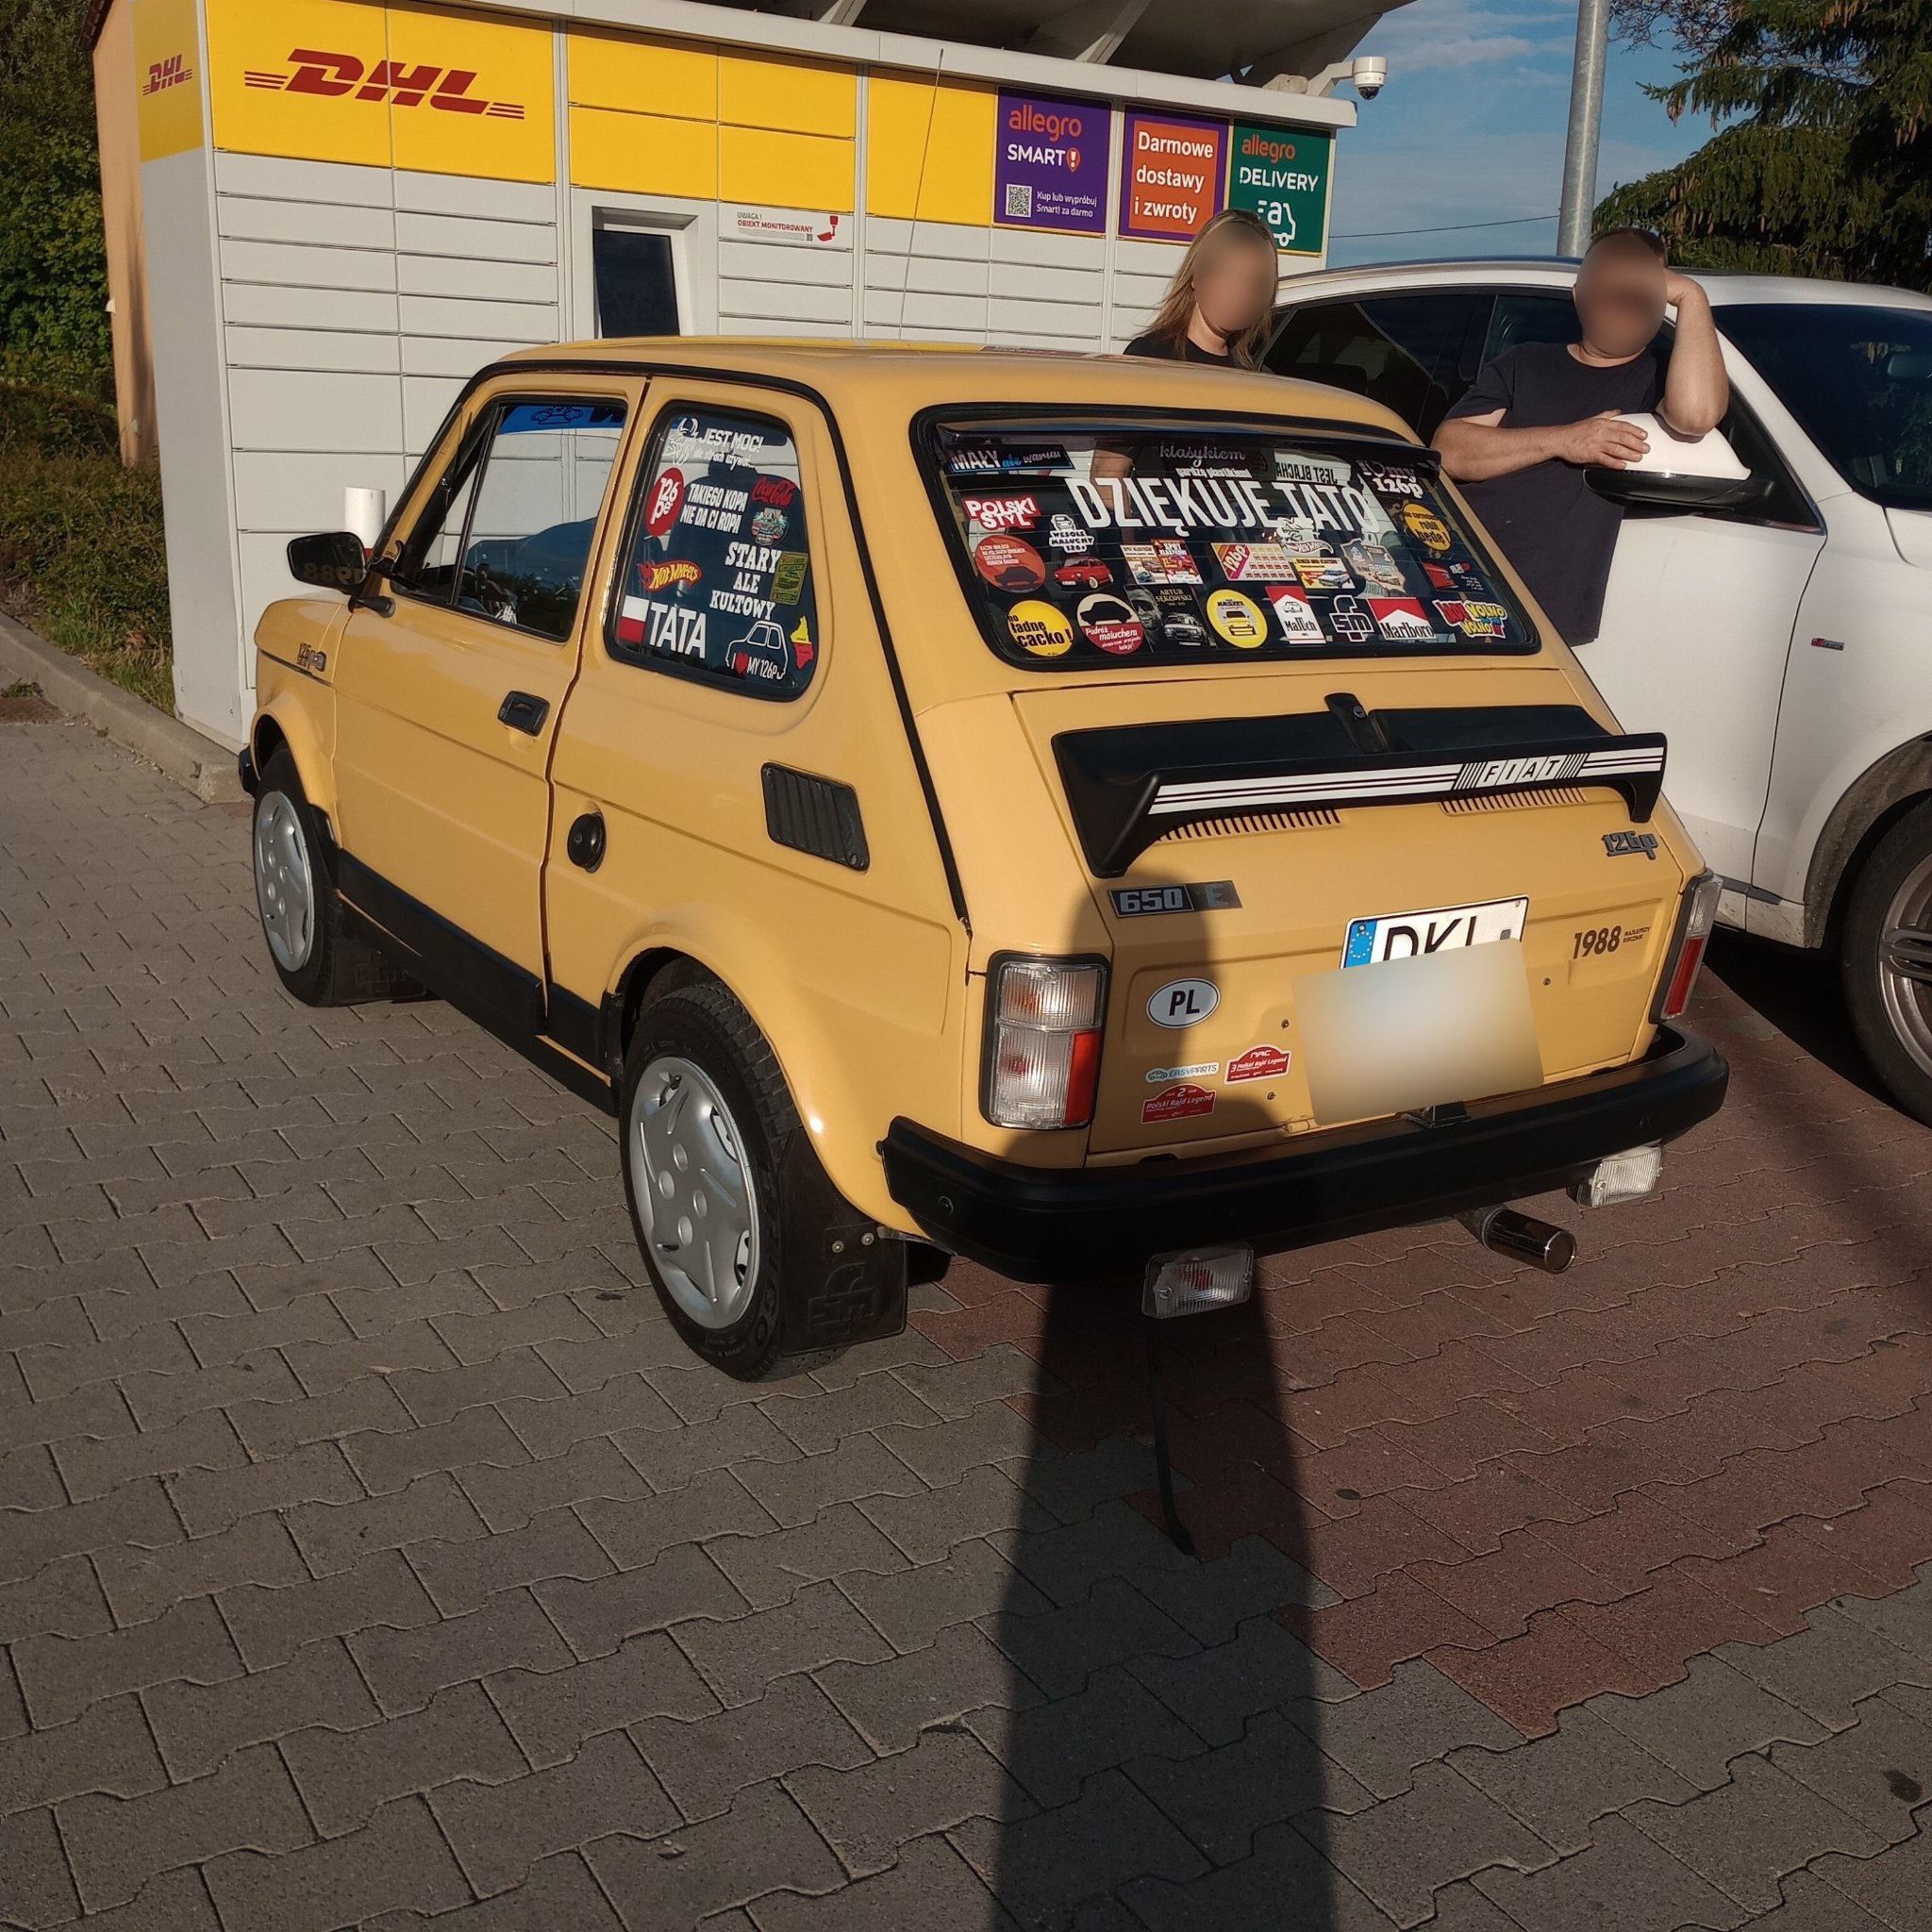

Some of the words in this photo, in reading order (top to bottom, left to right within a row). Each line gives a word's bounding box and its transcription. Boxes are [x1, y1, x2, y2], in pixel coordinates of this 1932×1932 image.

[148, 54, 184, 92] DHL
[285, 48, 490, 114] DHL
[1008, 104, 1082, 142] allegro
[1138, 131, 1213, 158] Darmowe
[1241, 134, 1296, 163] allegro
[1136, 165, 1205, 193] dostawy
[1239, 166, 1319, 192] DELIVERY
[1036, 203, 1060, 215] Smart!
[1061, 208, 1070, 216] za
[1071, 208, 1093, 218] darmo
[1037, 191, 1051, 202] Kup
[1052, 192, 1064, 202] lub
[1064, 194, 1097, 208] wypróbuj
[1134, 196, 1140, 215] i
[1143, 201, 1197, 225] zwroty
[737, 220, 760, 229] OBIEKT
[761, 222, 813, 234] MONITOROWANY
[698, 427, 733, 448] JEST
[730, 432, 764, 454] MOC!
[951, 450, 1001, 470] MAŁY
[1159, 445, 1246, 467] klasykiem
[658, 477, 680, 501] 126
[688, 483, 722, 508] TAKIEGO
[723, 489, 749, 513] KOPA
[1373, 477, 1424, 499] 126p
[679, 504, 695, 524] NIE
[695, 508, 708, 527] DA
[717, 512, 742, 535] ROPA
[964, 497, 1037, 517] POLSKI
[1271, 481, 1381, 533] TATO
[981, 511, 1032, 530] STYL
[725, 541, 783, 574] STARY
[733, 572, 761, 594] ALE
[709, 590, 776, 621] KULTOWY
[649, 602, 707, 659] TATA
[1010, 620, 1047, 634] ładne
[1017, 630, 1065, 648] cacko
[1379, 623, 1434, 640] Marlboro
[746, 658, 760, 676] MY
[1484, 759, 1560, 783] FIAT
[1601, 830, 1658, 860] 126p
[1119, 888, 1183, 913] 650
[1205, 883, 1229, 908] E
[1573, 925, 1622, 959] 1988
[1169, 989, 1200, 1016] PL
[1169, 1064, 1217, 1076] EASYPARTS
[1230, 1064, 1237, 1073] 3
[1146, 1100, 1169, 1110] Polski
[1169, 1097, 1186, 1108] Rajd
[1187, 1092, 1214, 1104] Legend
[1177, 1087, 1186, 1097] 2
